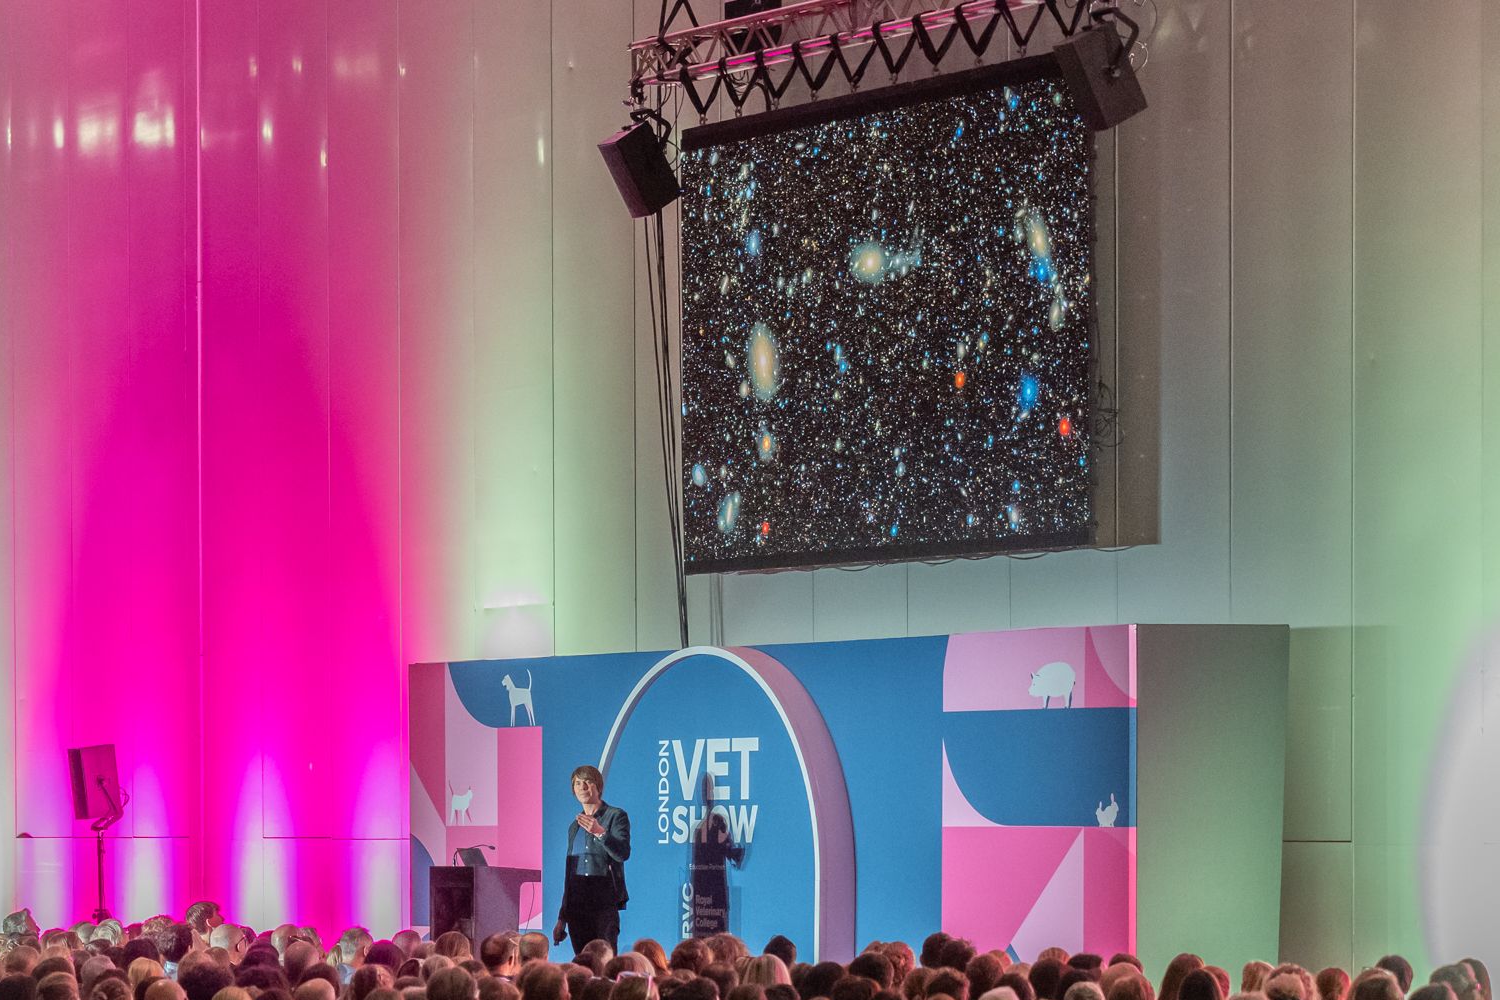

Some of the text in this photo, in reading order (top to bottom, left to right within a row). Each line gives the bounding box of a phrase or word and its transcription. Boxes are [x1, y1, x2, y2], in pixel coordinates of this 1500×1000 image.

[672, 737, 759, 800] VET
[658, 740, 669, 844] LONDON
[672, 805, 758, 844] SHOW
[682, 882, 694, 939] RVC
[695, 894, 713, 907] Royal
[695, 906, 726, 919] Veterinary
[695, 917, 718, 930] College
